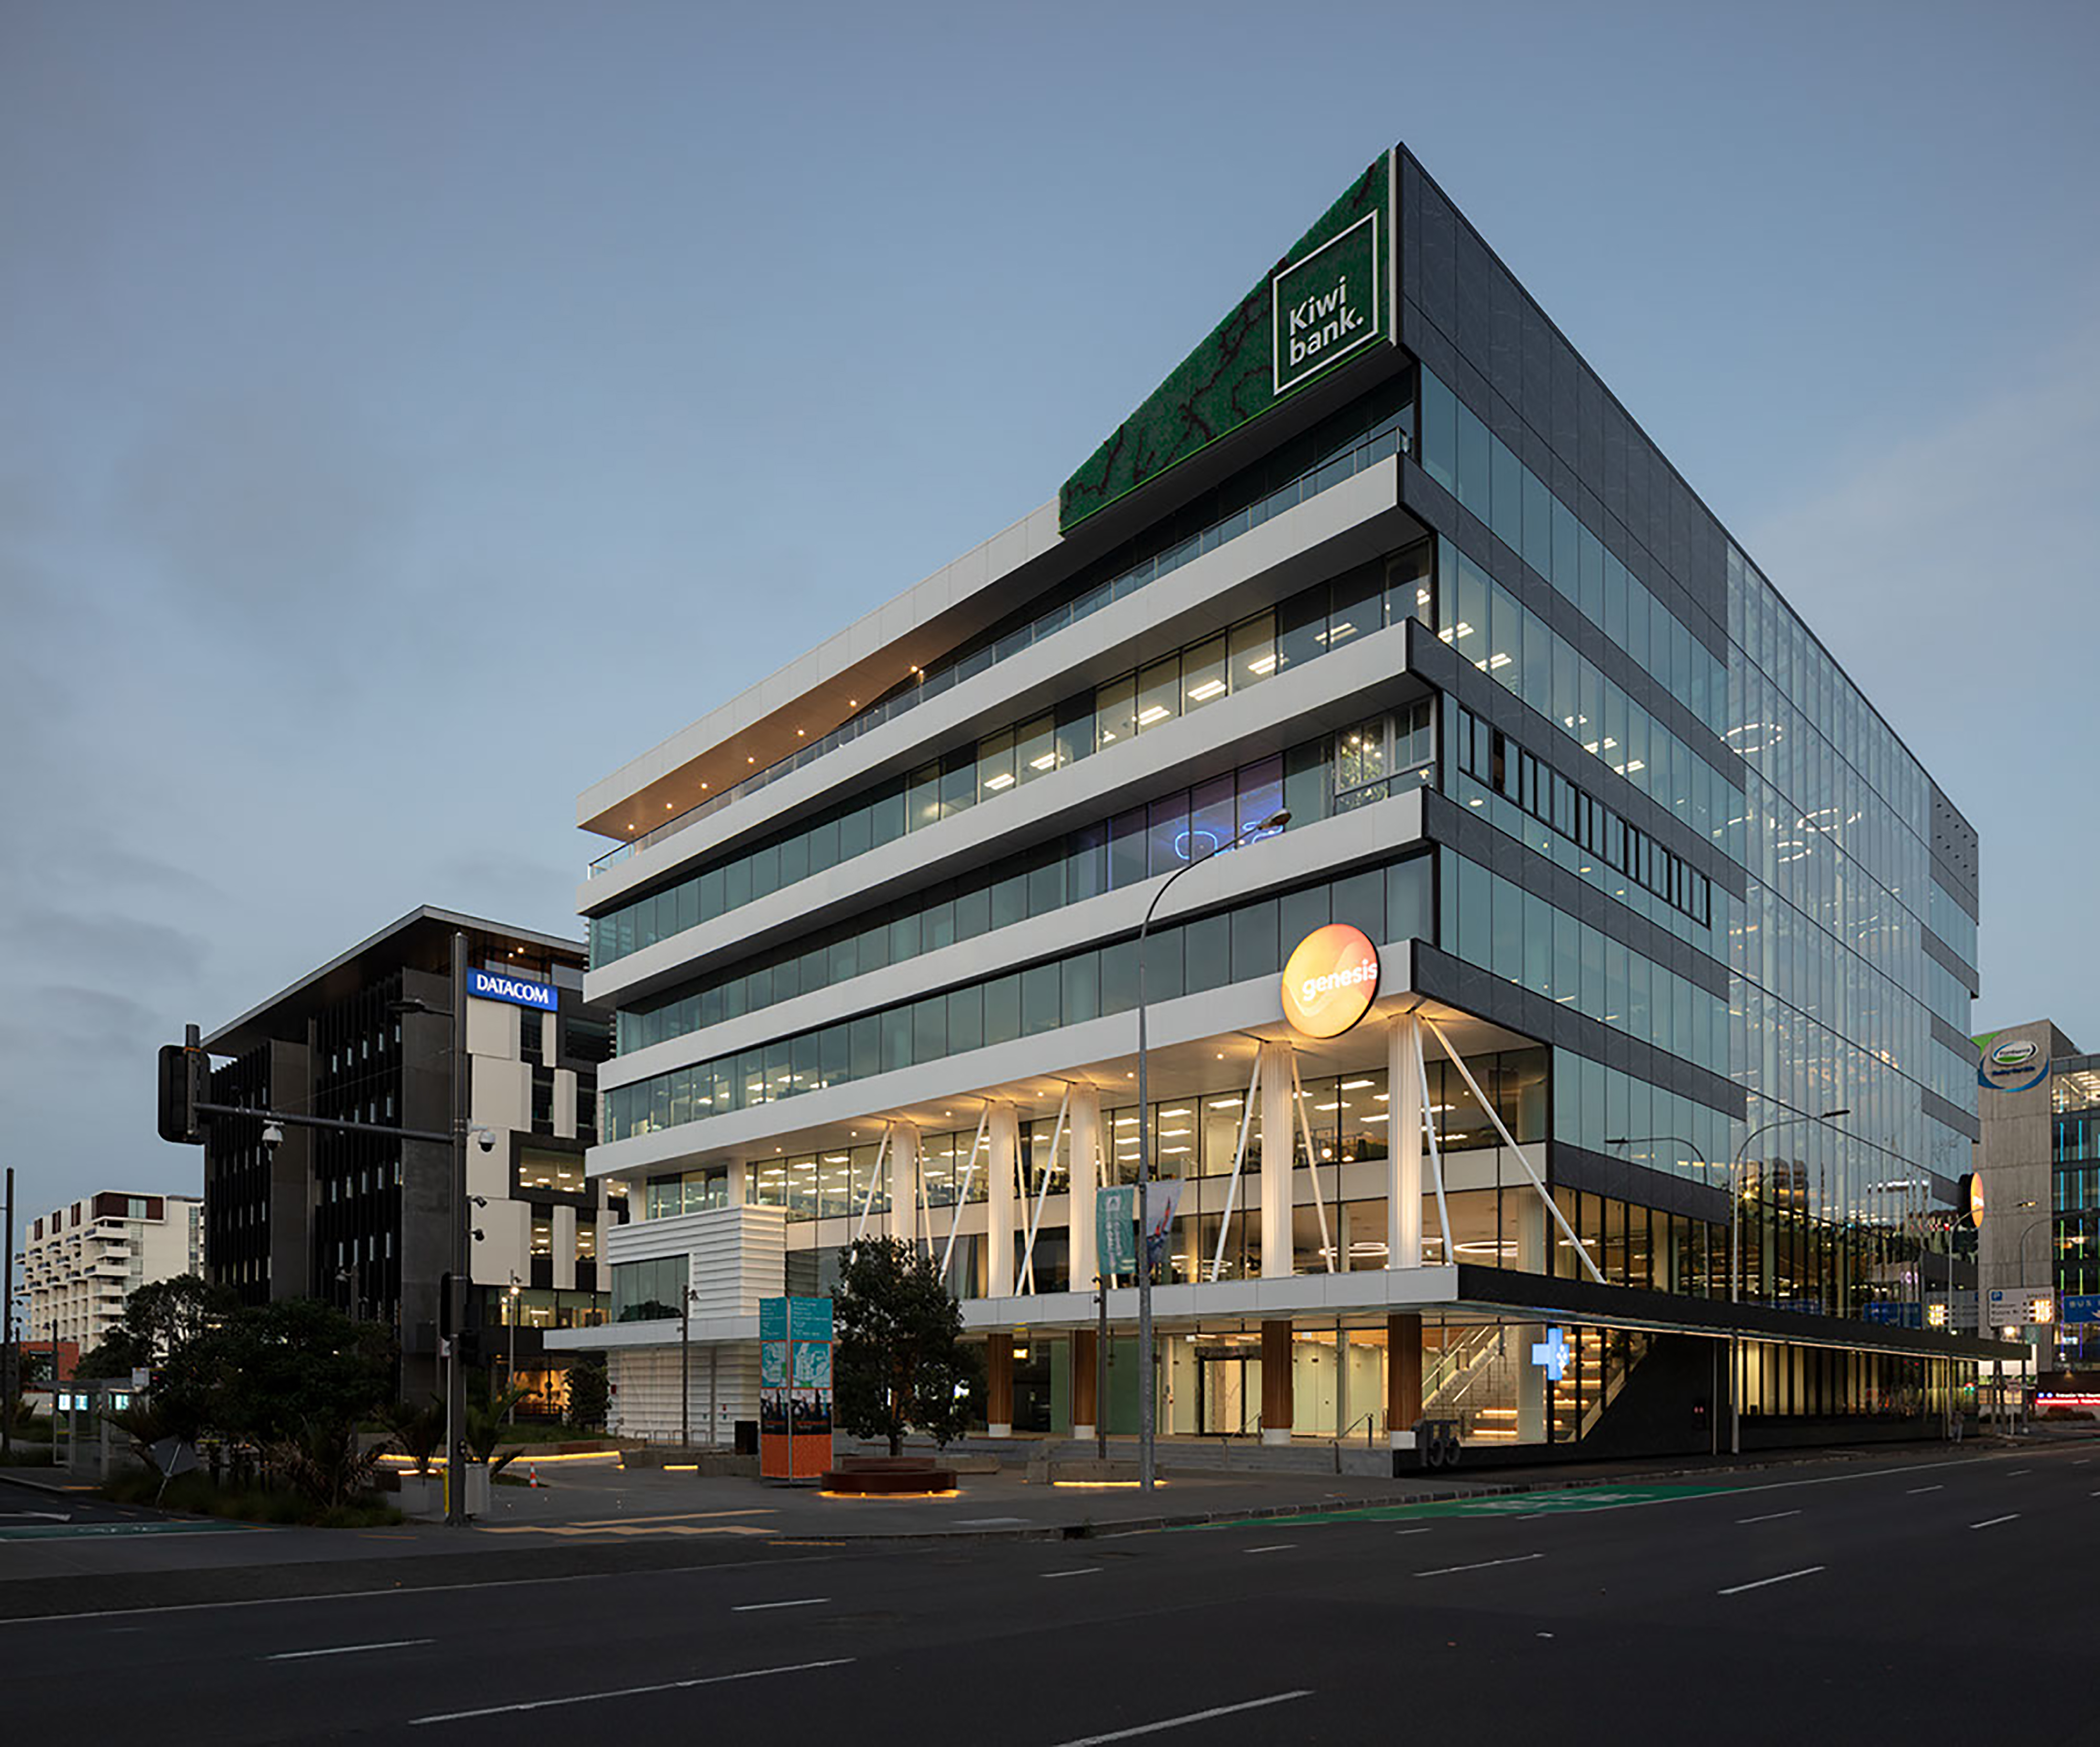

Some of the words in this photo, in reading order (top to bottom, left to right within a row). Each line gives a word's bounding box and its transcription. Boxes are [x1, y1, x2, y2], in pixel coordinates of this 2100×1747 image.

[1290, 276, 1346, 336] Kiwi
[1290, 306, 1364, 366] bank.
[477, 974, 549, 1004] DATACOM
[1302, 959, 1378, 1001] genesis
